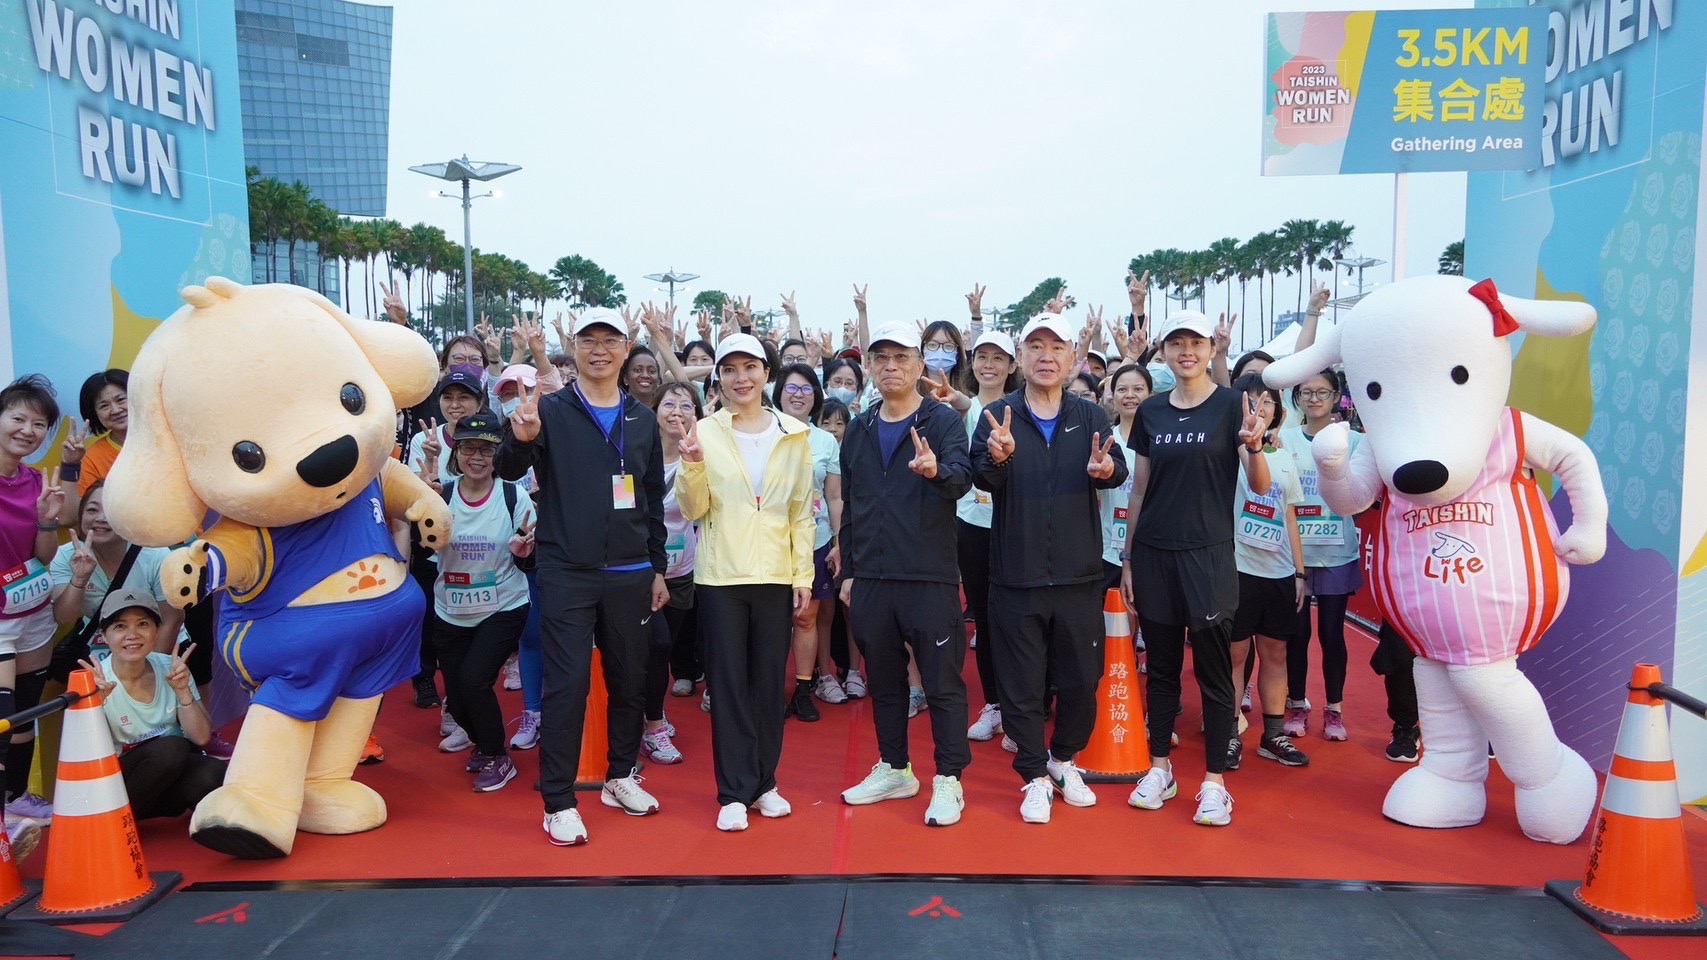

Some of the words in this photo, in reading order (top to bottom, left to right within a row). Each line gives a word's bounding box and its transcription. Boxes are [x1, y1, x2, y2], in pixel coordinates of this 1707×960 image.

[1395, 26, 1529, 68] 3.5KM
[26, 0, 216, 132] WOMEN
[1302, 66, 1325, 74] 2023
[1289, 76, 1338, 88] TAISHIN
[1277, 89, 1351, 106] WOMEN
[1392, 76, 1525, 123] 集合處
[1292, 107, 1333, 124] RUN
[1540, 69, 1623, 168] RUN
[78, 105, 182, 200] RUN
[1391, 136, 1477, 153] Gathering
[1481, 135, 1523, 150] Area
[1155, 432, 1205, 445] COACH
[1304, 486, 1319, 496] RU
[1403, 502, 1494, 534] TAISHIN
[1244, 521, 1282, 542] 07270
[1299, 523, 1338, 536] 07282
[450, 542, 496, 552] WOMEN
[461, 552, 486, 561] RUN
[1424, 556, 1484, 584] Life
[13, 578, 49, 604] 07119
[451, 590, 491, 604] 07113
[1108, 661, 1129, 744] 路跑協會
